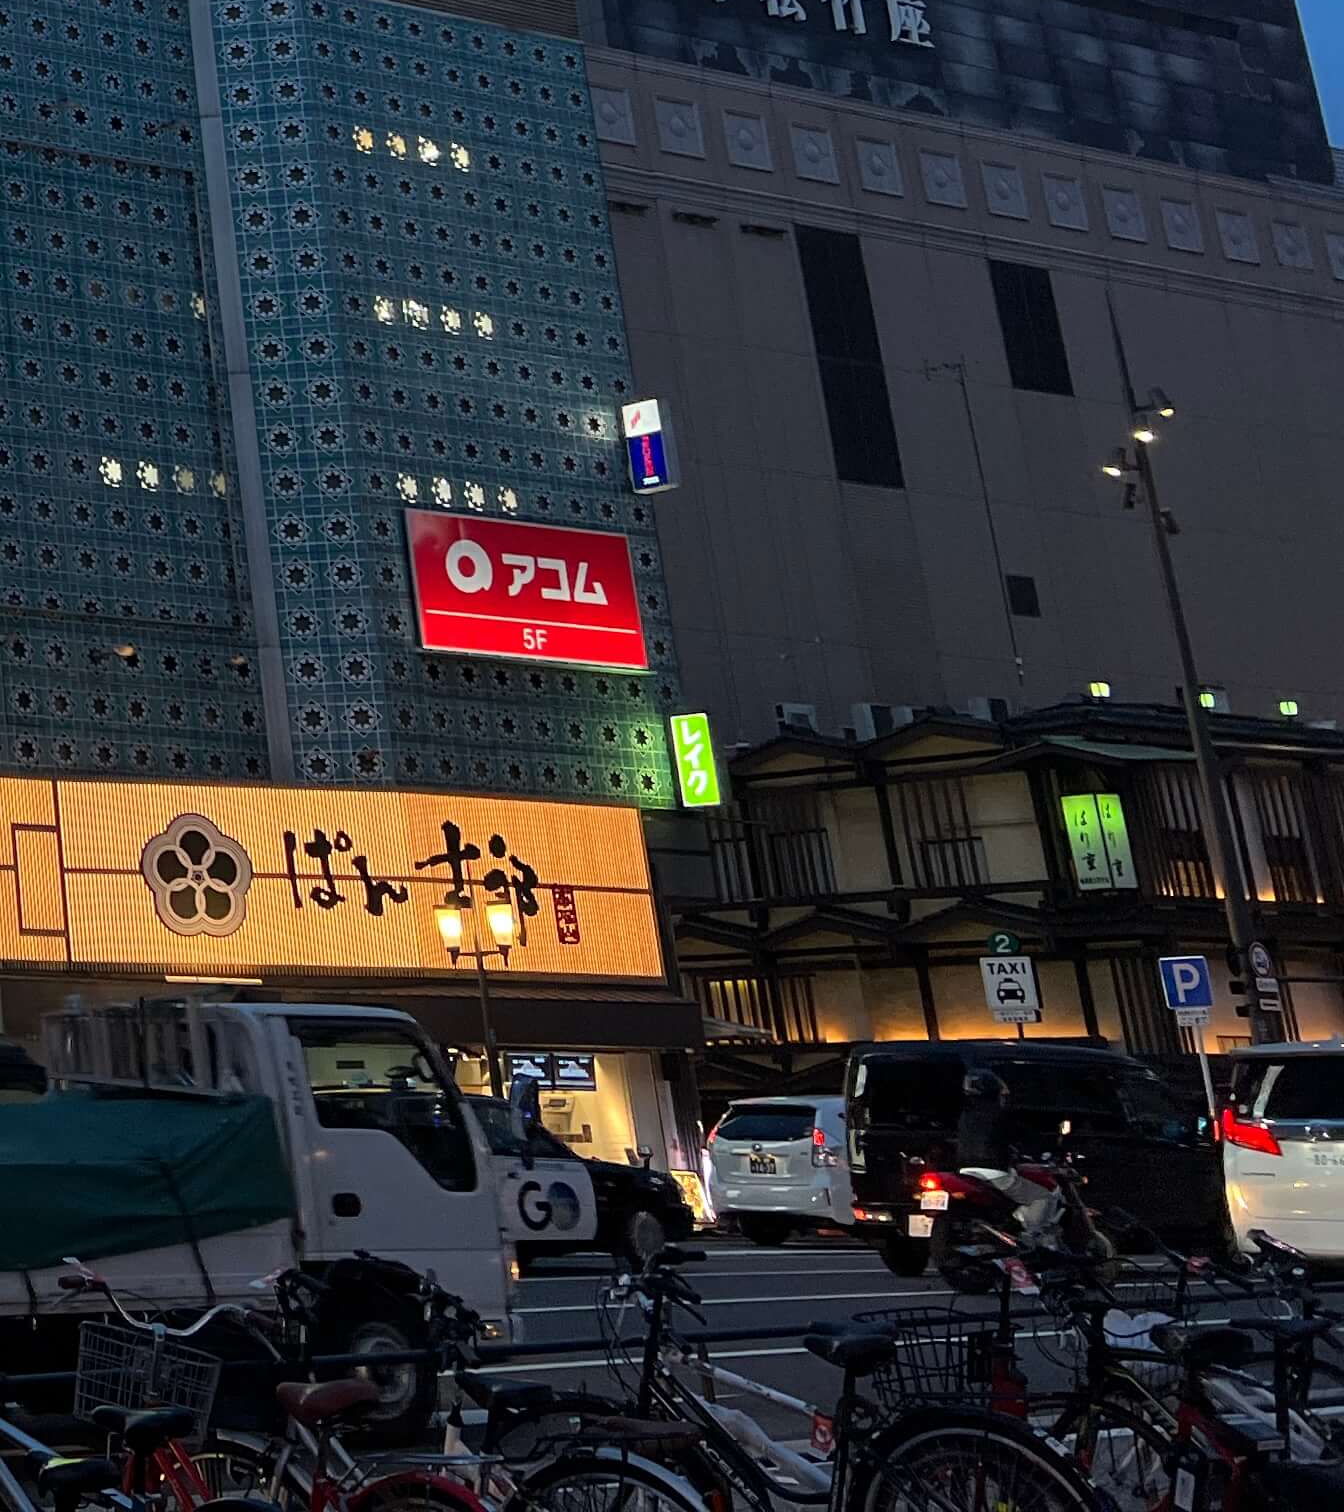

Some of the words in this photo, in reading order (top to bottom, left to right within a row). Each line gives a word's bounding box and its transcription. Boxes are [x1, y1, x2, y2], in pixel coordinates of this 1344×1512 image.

[500, 552, 609, 607] アコム
[522, 627, 548, 651] 5F
[680, 720, 711, 796] レイク
[995, 934, 1011, 953] 2
[986, 962, 1027, 976] TAXI
[1172, 962, 1200, 1003] P
